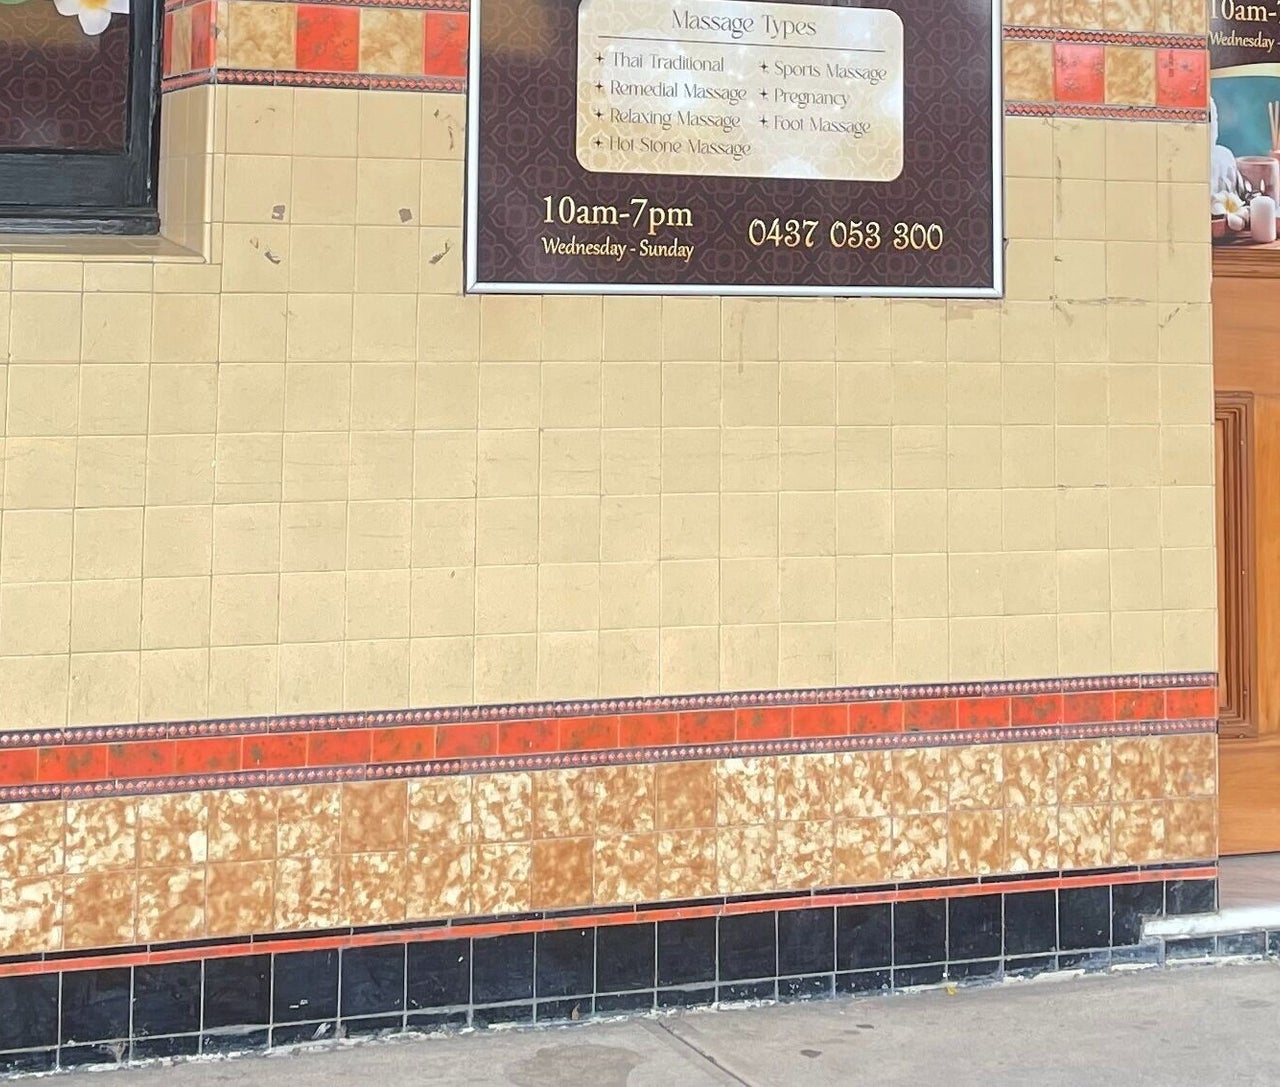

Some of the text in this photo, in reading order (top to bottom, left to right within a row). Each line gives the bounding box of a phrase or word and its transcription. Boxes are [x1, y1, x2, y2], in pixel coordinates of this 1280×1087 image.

[672, 9, 817, 40] Massage Types
[1208, 30, 1275, 53] Wednesday
[613, 51, 725, 73] Thai Traditional
[774, 60, 888, 86] Sports Massage
[610, 79, 747, 106] Remedial Massage
[774, 87, 850, 110] Pregnancy
[610, 107, 741, 133] Relaxing Massage
[774, 115, 872, 139] Foot Massage
[609, 136, 752, 162] Hot Stone Massage
[542, 196, 694, 235] 10am-7pm
[748, 218, 944, 251] 0437 053 300
[542, 236, 627, 262] Wednesday
[638, 239, 695, 263] Sunday
